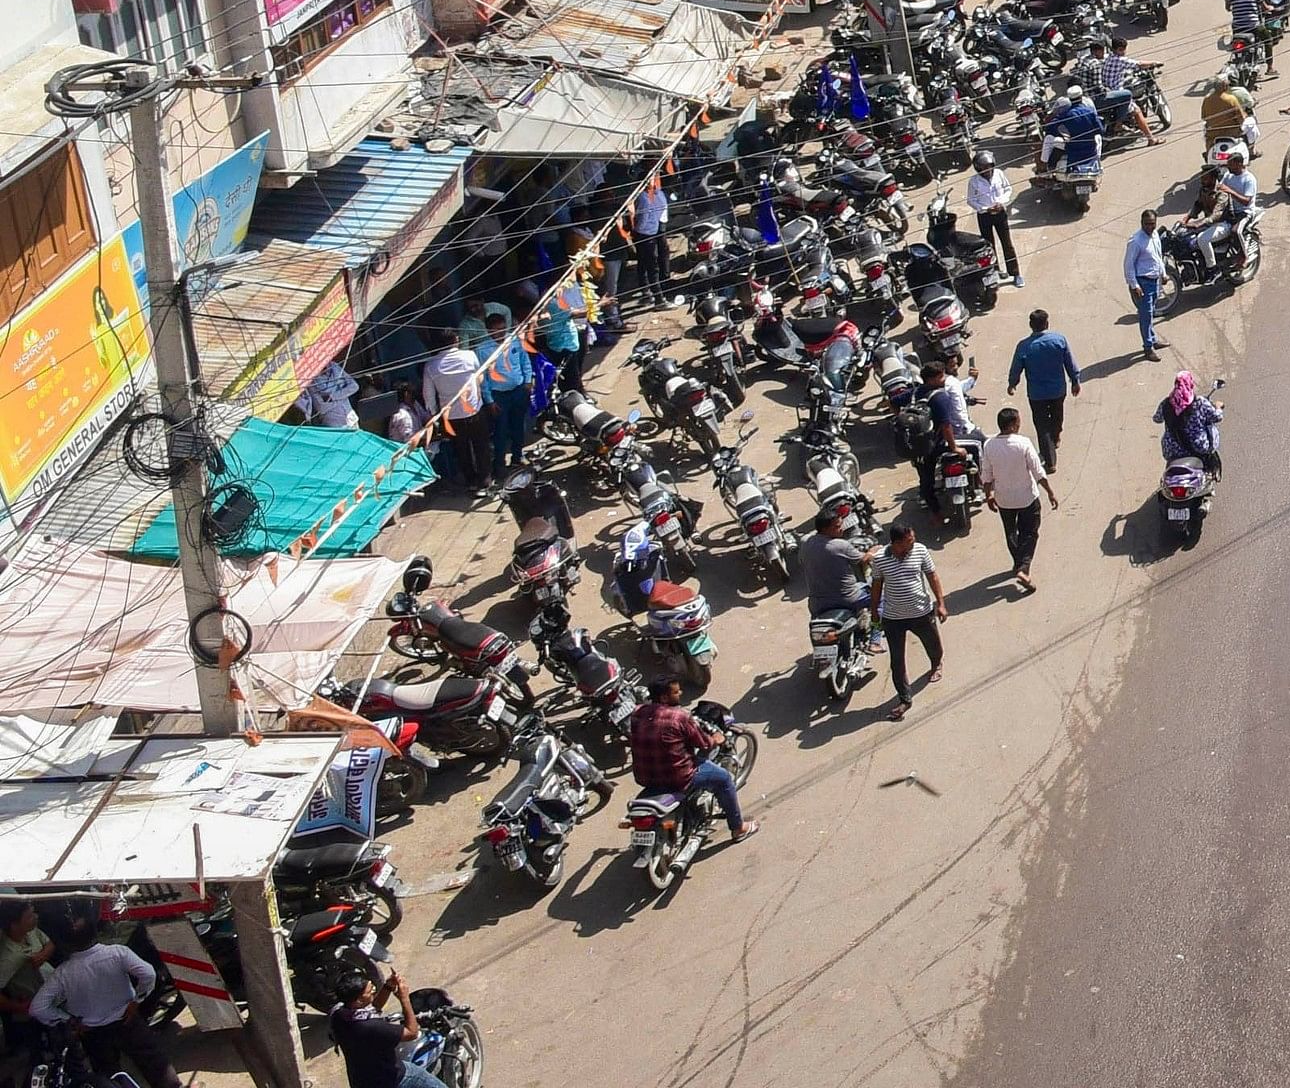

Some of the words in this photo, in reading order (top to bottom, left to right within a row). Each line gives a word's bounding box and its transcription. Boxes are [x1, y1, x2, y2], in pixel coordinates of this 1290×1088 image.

[32, 471, 53, 499] OM
[51, 415, 105, 480] GENERAL
[105, 377, 140, 422] STORE
